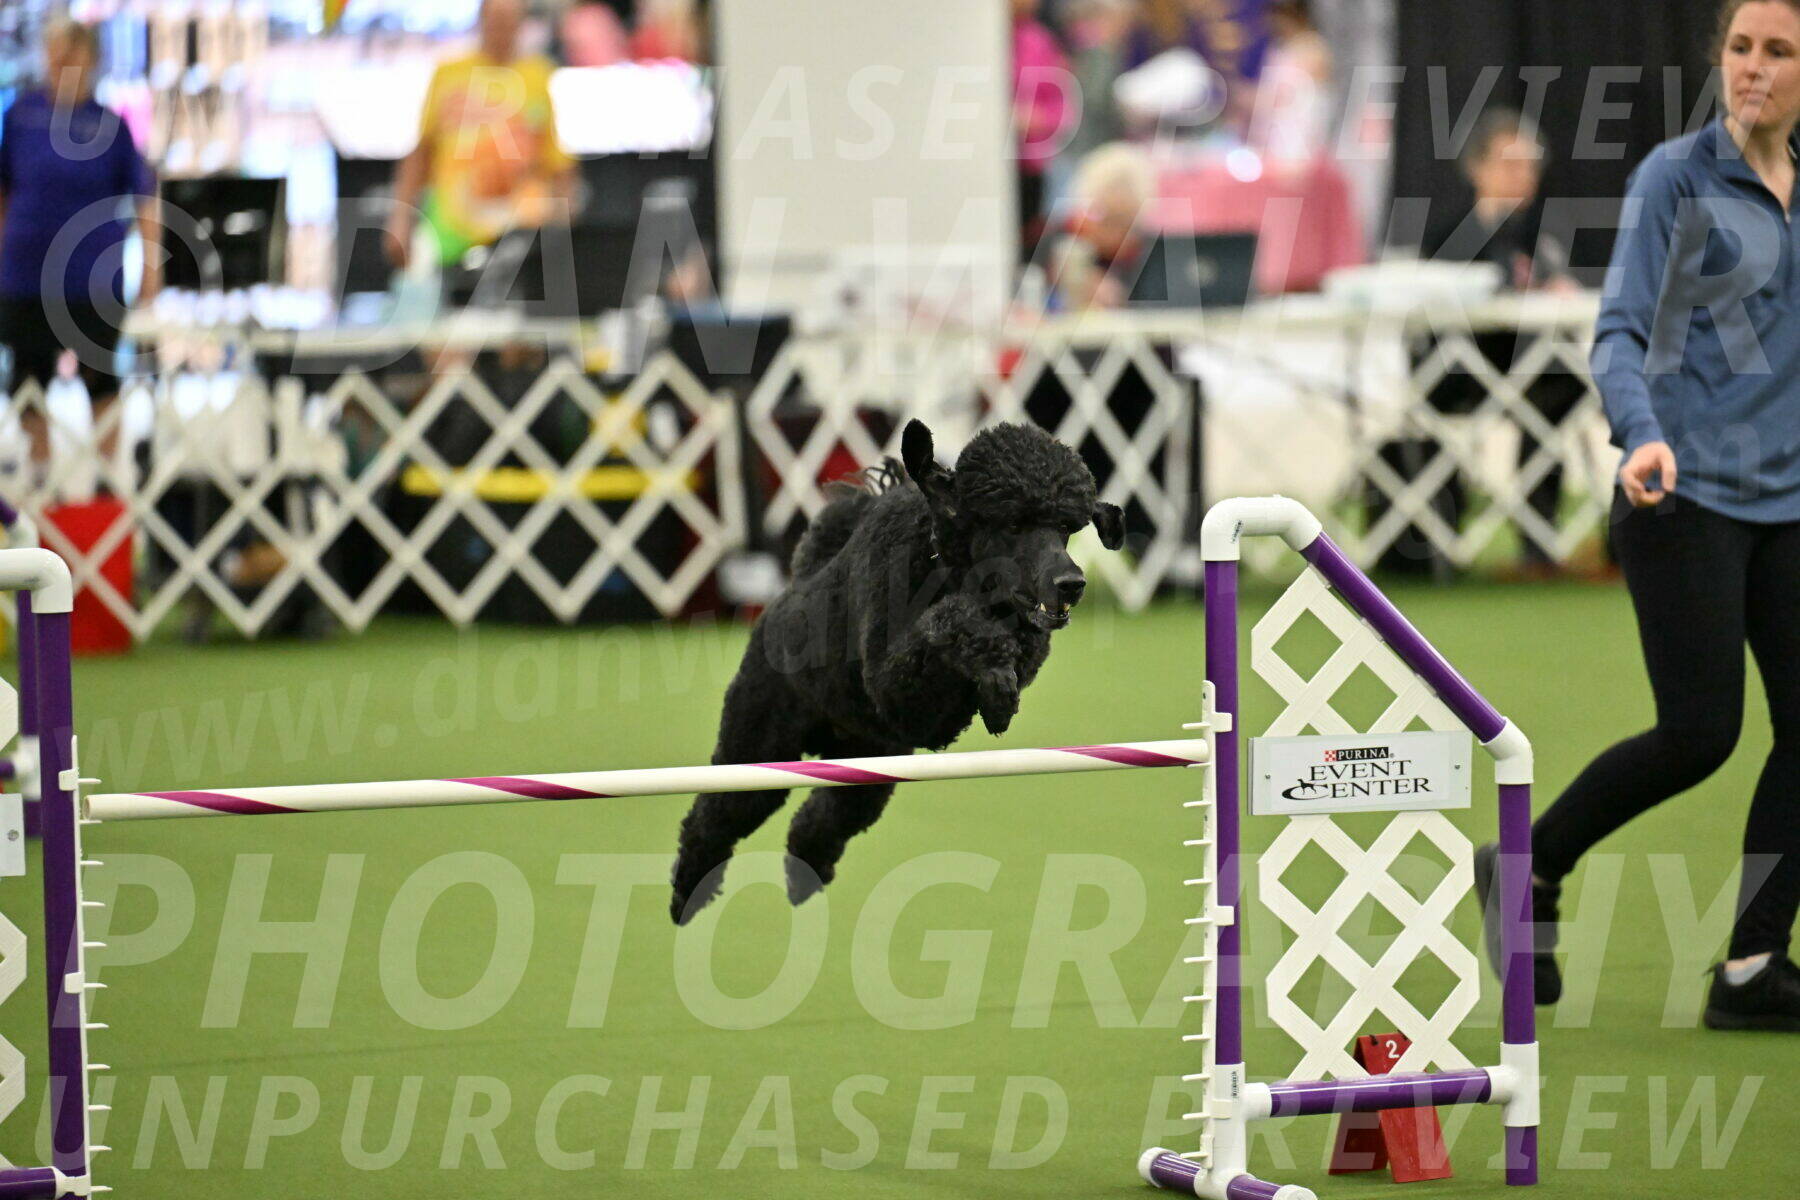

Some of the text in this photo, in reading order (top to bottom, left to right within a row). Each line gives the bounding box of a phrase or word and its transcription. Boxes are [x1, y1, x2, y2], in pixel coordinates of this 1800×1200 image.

[1337, 747, 1388, 761] PURINA
[1310, 759, 1412, 782] EVENT
[1281, 776, 1434, 801] CENTER
[1385, 1039, 1400, 1059] 2
